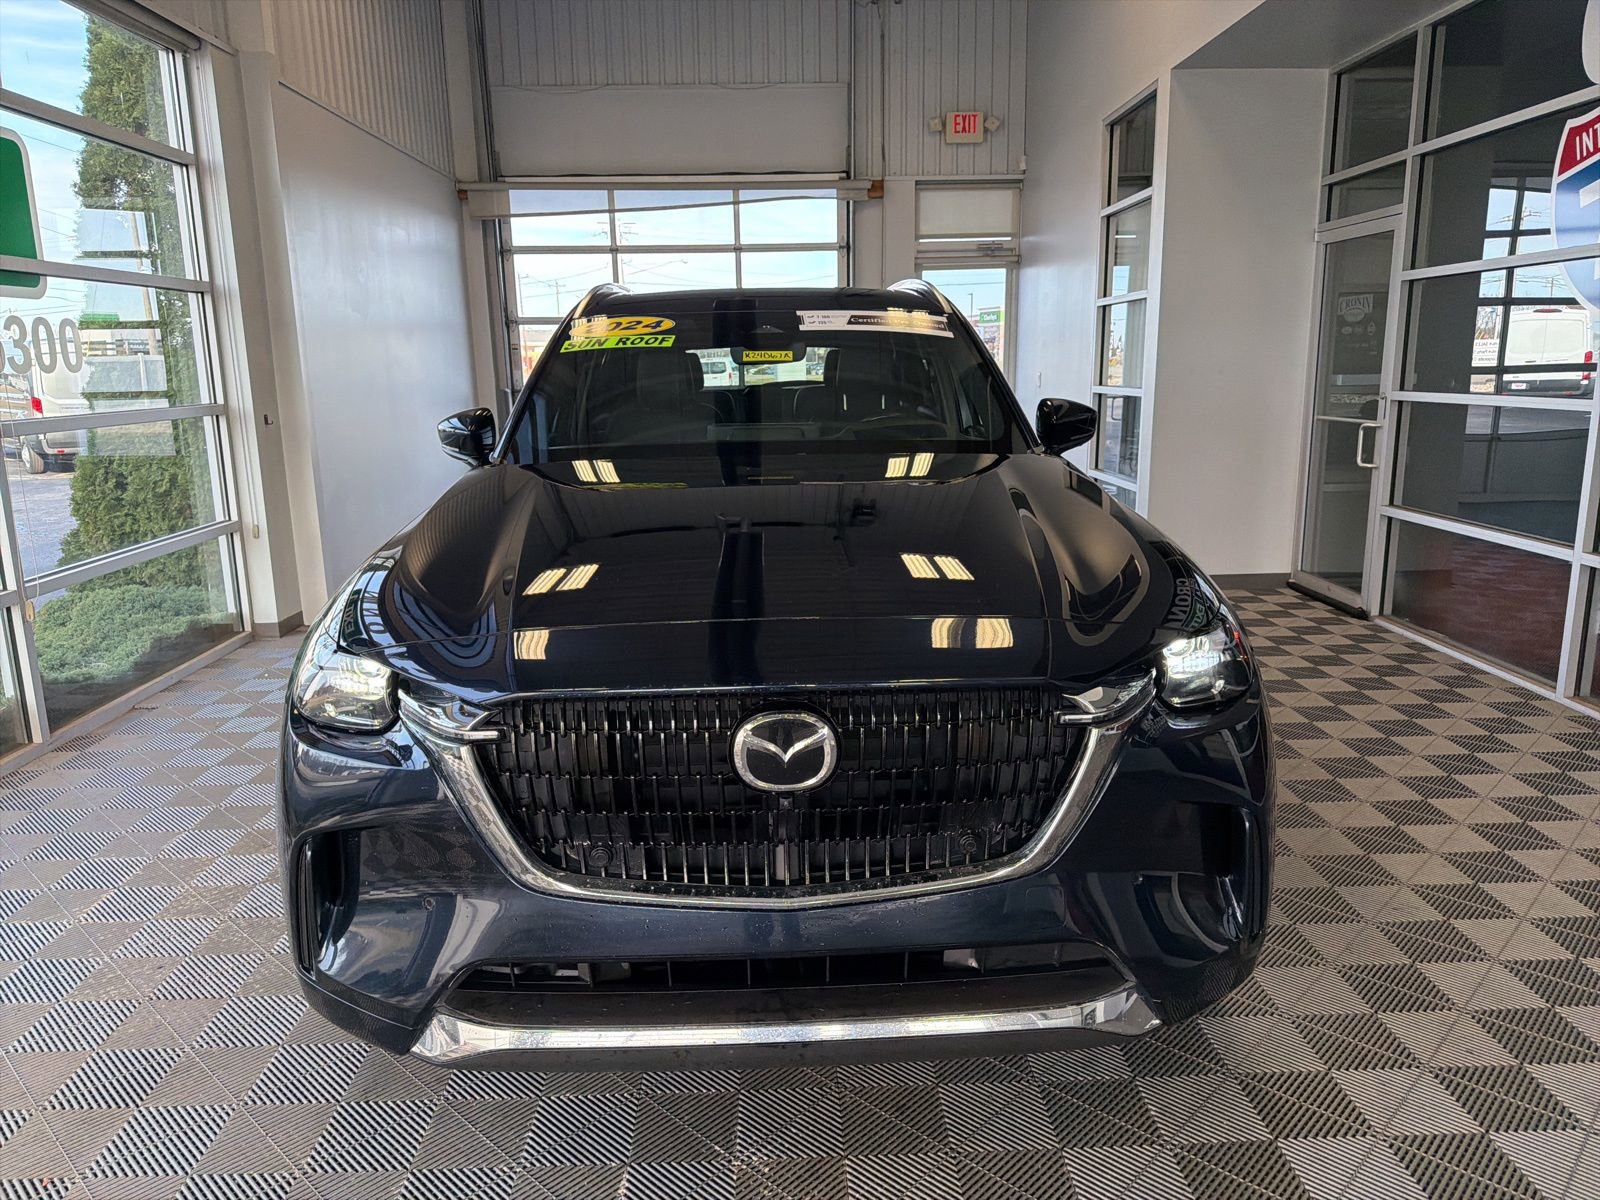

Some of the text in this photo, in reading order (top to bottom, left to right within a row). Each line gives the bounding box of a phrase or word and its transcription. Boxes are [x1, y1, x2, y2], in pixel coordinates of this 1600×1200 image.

[953, 114, 978, 133] EXIT
[0, 314, 83, 375] 300
[564, 336, 672, 351] SUN ROOF
